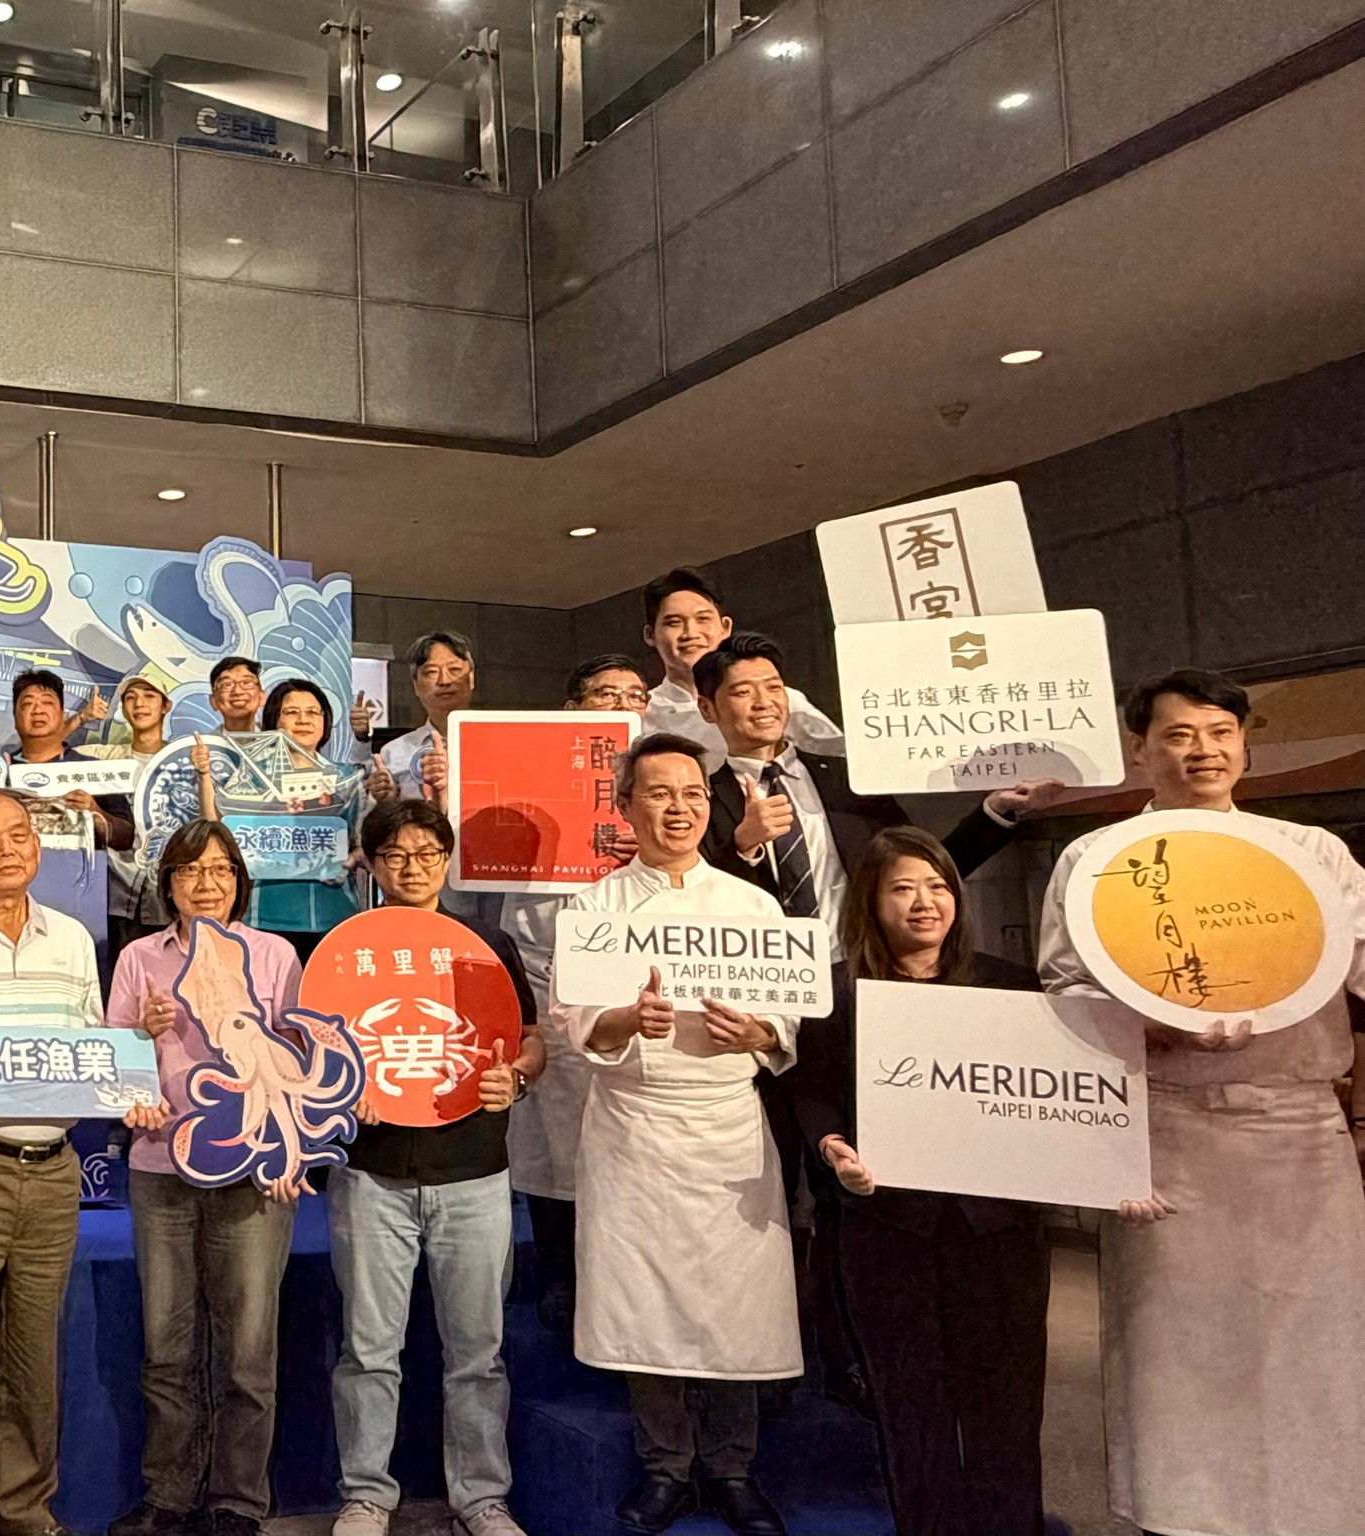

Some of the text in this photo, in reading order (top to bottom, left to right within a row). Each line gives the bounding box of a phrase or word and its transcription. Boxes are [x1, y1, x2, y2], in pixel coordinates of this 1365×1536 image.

[861, 679, 1094, 710] 台北遠東香格里拉
[863, 706, 1096, 739] SHANGRI-LA
[570, 735, 586, 770] 上海
[908, 741, 1055, 760] FAR EASTERN
[949, 762, 1018, 778] TAIPEI
[235, 824, 338, 853] 永續漁業
[472, 864, 545, 874] SHANGHAI
[1195, 897, 1257, 915] MOON
[1199, 909, 1296, 930] PAVILION
[570, 922, 817, 962] Le MERIDIEN
[354, 947, 454, 977] 萬里蟹
[668, 962, 815, 984] TAIPEI BANQIAO
[873, 1056, 1130, 1108] Le MERIDIEN
[976, 1099, 1131, 1129] TAIPEI BANQIAO
